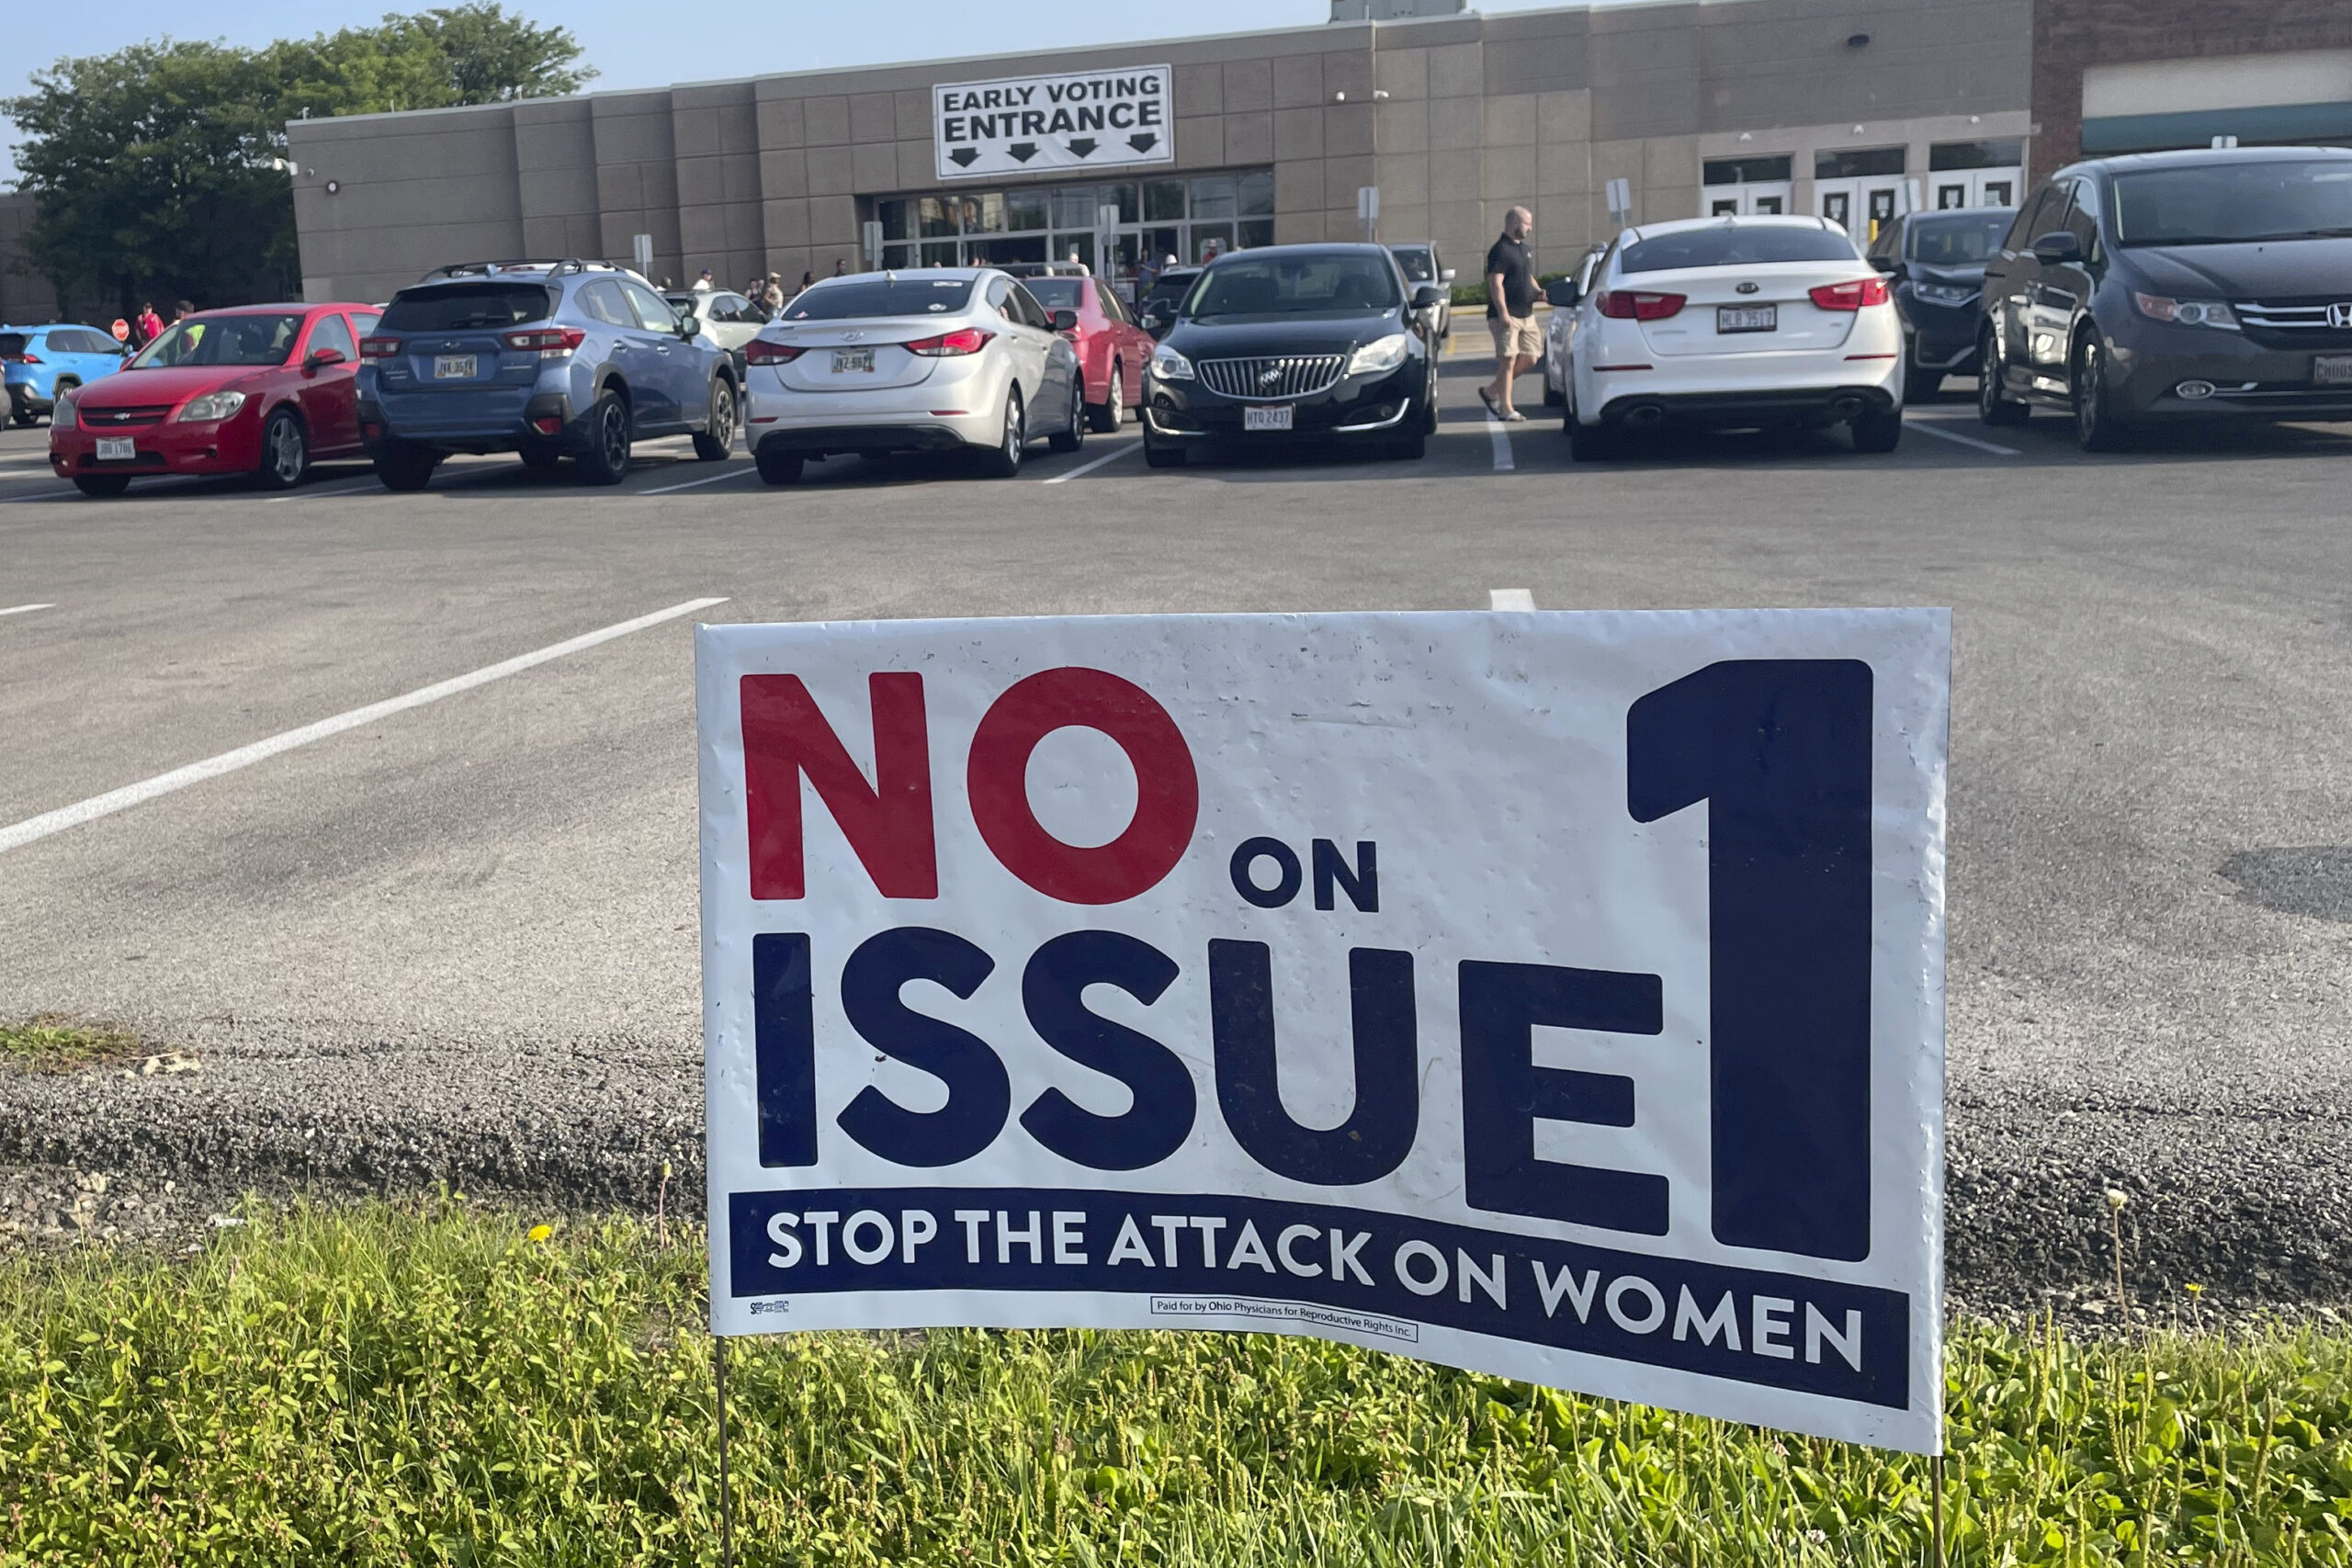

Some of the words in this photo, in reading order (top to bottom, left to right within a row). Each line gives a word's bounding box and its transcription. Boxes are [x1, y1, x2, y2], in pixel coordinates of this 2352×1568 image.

[944, 85, 1036, 112] EARLY
[1046, 75, 1160, 103] VOTING
[944, 100, 1162, 142] ENTRANCE
[740, 666, 1199, 906] NO
[1229, 836, 1379, 913] ON
[752, 926, 1669, 1237] ISSUE
[1626, 659, 1873, 1263] 1
[766, 1210, 938, 1269] STOP
[955, 1210, 1089, 1265] THE
[1107, 1213, 1375, 1286] ATTACK
[1394, 1239, 1507, 1312] ON
[1531, 1259, 1862, 1373] WOMEN
[1158, 1301, 1177, 1311] Paid
[1180, 1301, 1193, 1311] for
[1195, 1302, 1206, 1313] by
[1209, 1301, 1232, 1311] Ohio
[1234, 1302, 1283, 1315] Physicians
[1284, 1306, 1297, 1316] for
[1300, 1308, 1362, 1327] Reproductive
[1363, 1318, 1393, 1334] Rights
[1395, 1325, 1412, 1337] Inc.
